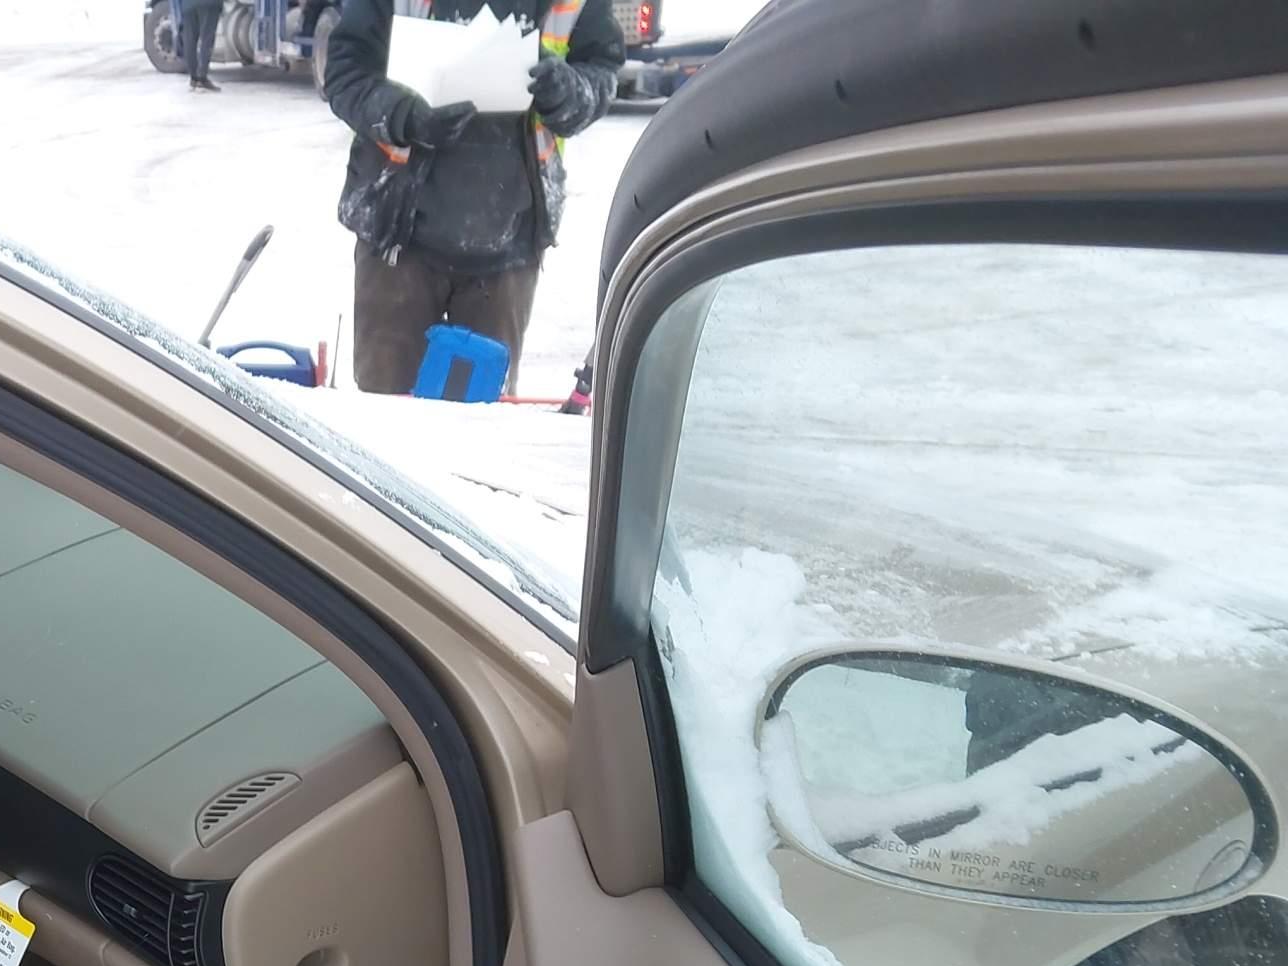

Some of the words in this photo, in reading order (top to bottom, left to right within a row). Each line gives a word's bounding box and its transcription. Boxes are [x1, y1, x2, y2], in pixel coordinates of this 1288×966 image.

[908, 858, 941, 873] THAN
[951, 864, 984, 878] THEY
[993, 872, 1045, 887] APPEAR
[928, 847, 941, 859] IN
[950, 851, 1001, 867] MIRROR
[1010, 860, 1036, 873] ARE
[1044, 866, 1099, 881] CLOSER
